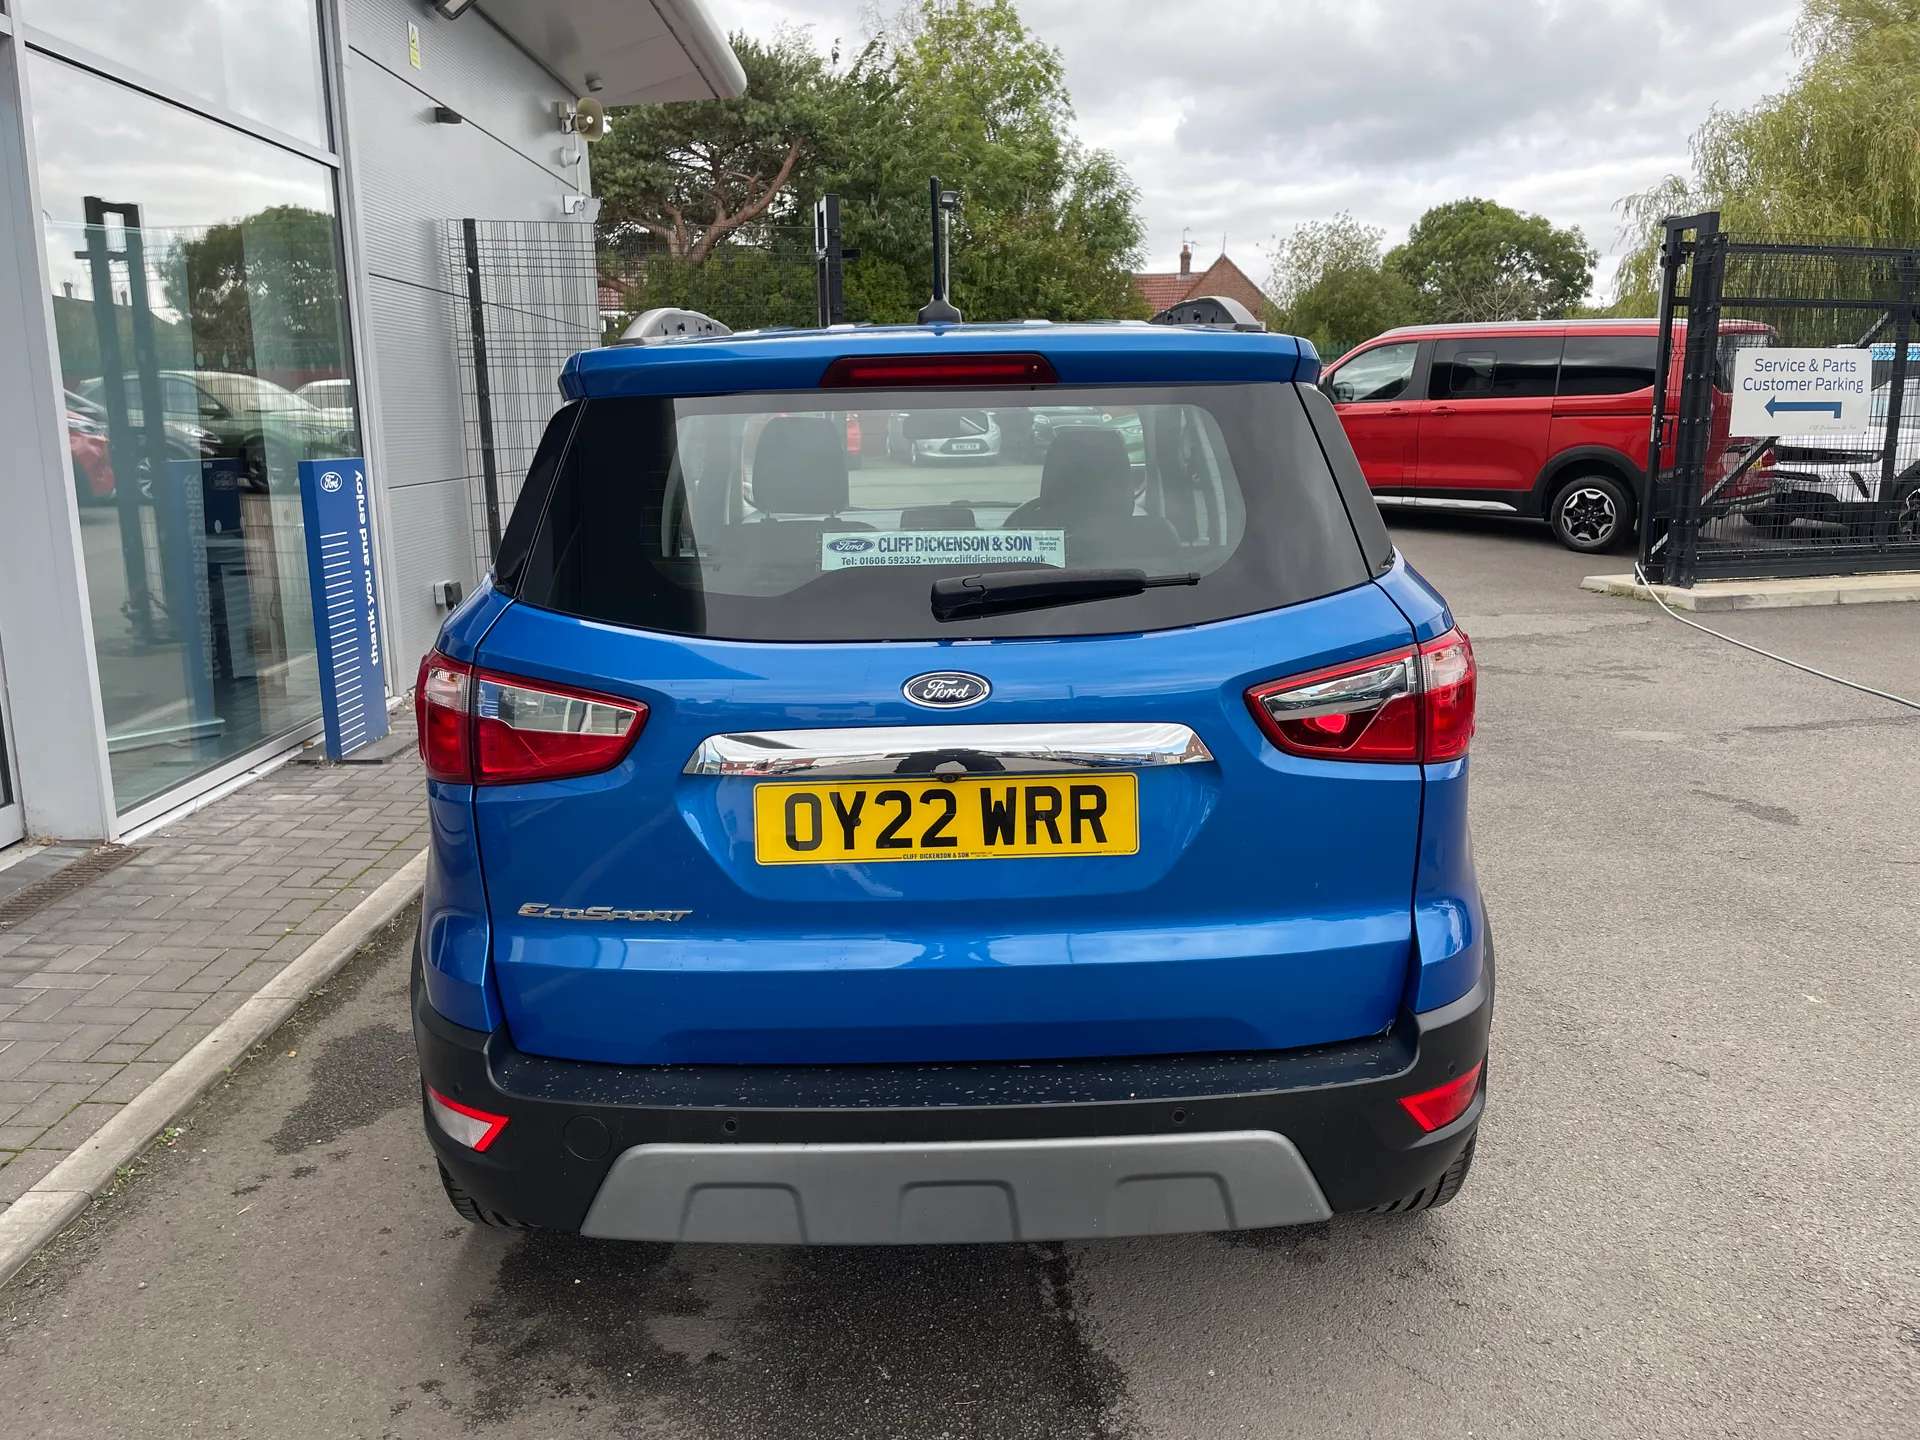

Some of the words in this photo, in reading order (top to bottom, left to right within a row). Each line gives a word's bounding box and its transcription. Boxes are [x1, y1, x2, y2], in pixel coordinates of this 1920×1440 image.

[1754, 358, 1806, 372] Service
[1808, 359, 1818, 372] &
[1822, 359, 1857, 372] Parts
[1743, 377, 1812, 391] Customer
[1815, 377, 1864, 393] Parking
[354, 469, 366, 525] enjoy
[359, 527, 370, 567] and
[841, 556, 857, 566] Tel:
[859, 556, 886, 565] 01606
[887, 556, 921, 565] 592352
[928, 554, 1046, 564] www.cliffdickenson.co.uk
[878, 537, 913, 552] CLIFF
[915, 536, 989, 552] DICKENSON
[992, 535, 1003, 551] &
[1005, 535, 1032, 551] SON
[364, 569, 375, 608] you
[367, 608, 379, 667] thank
[784, 787, 958, 852] OY22
[980, 784, 1107, 847] WRR
